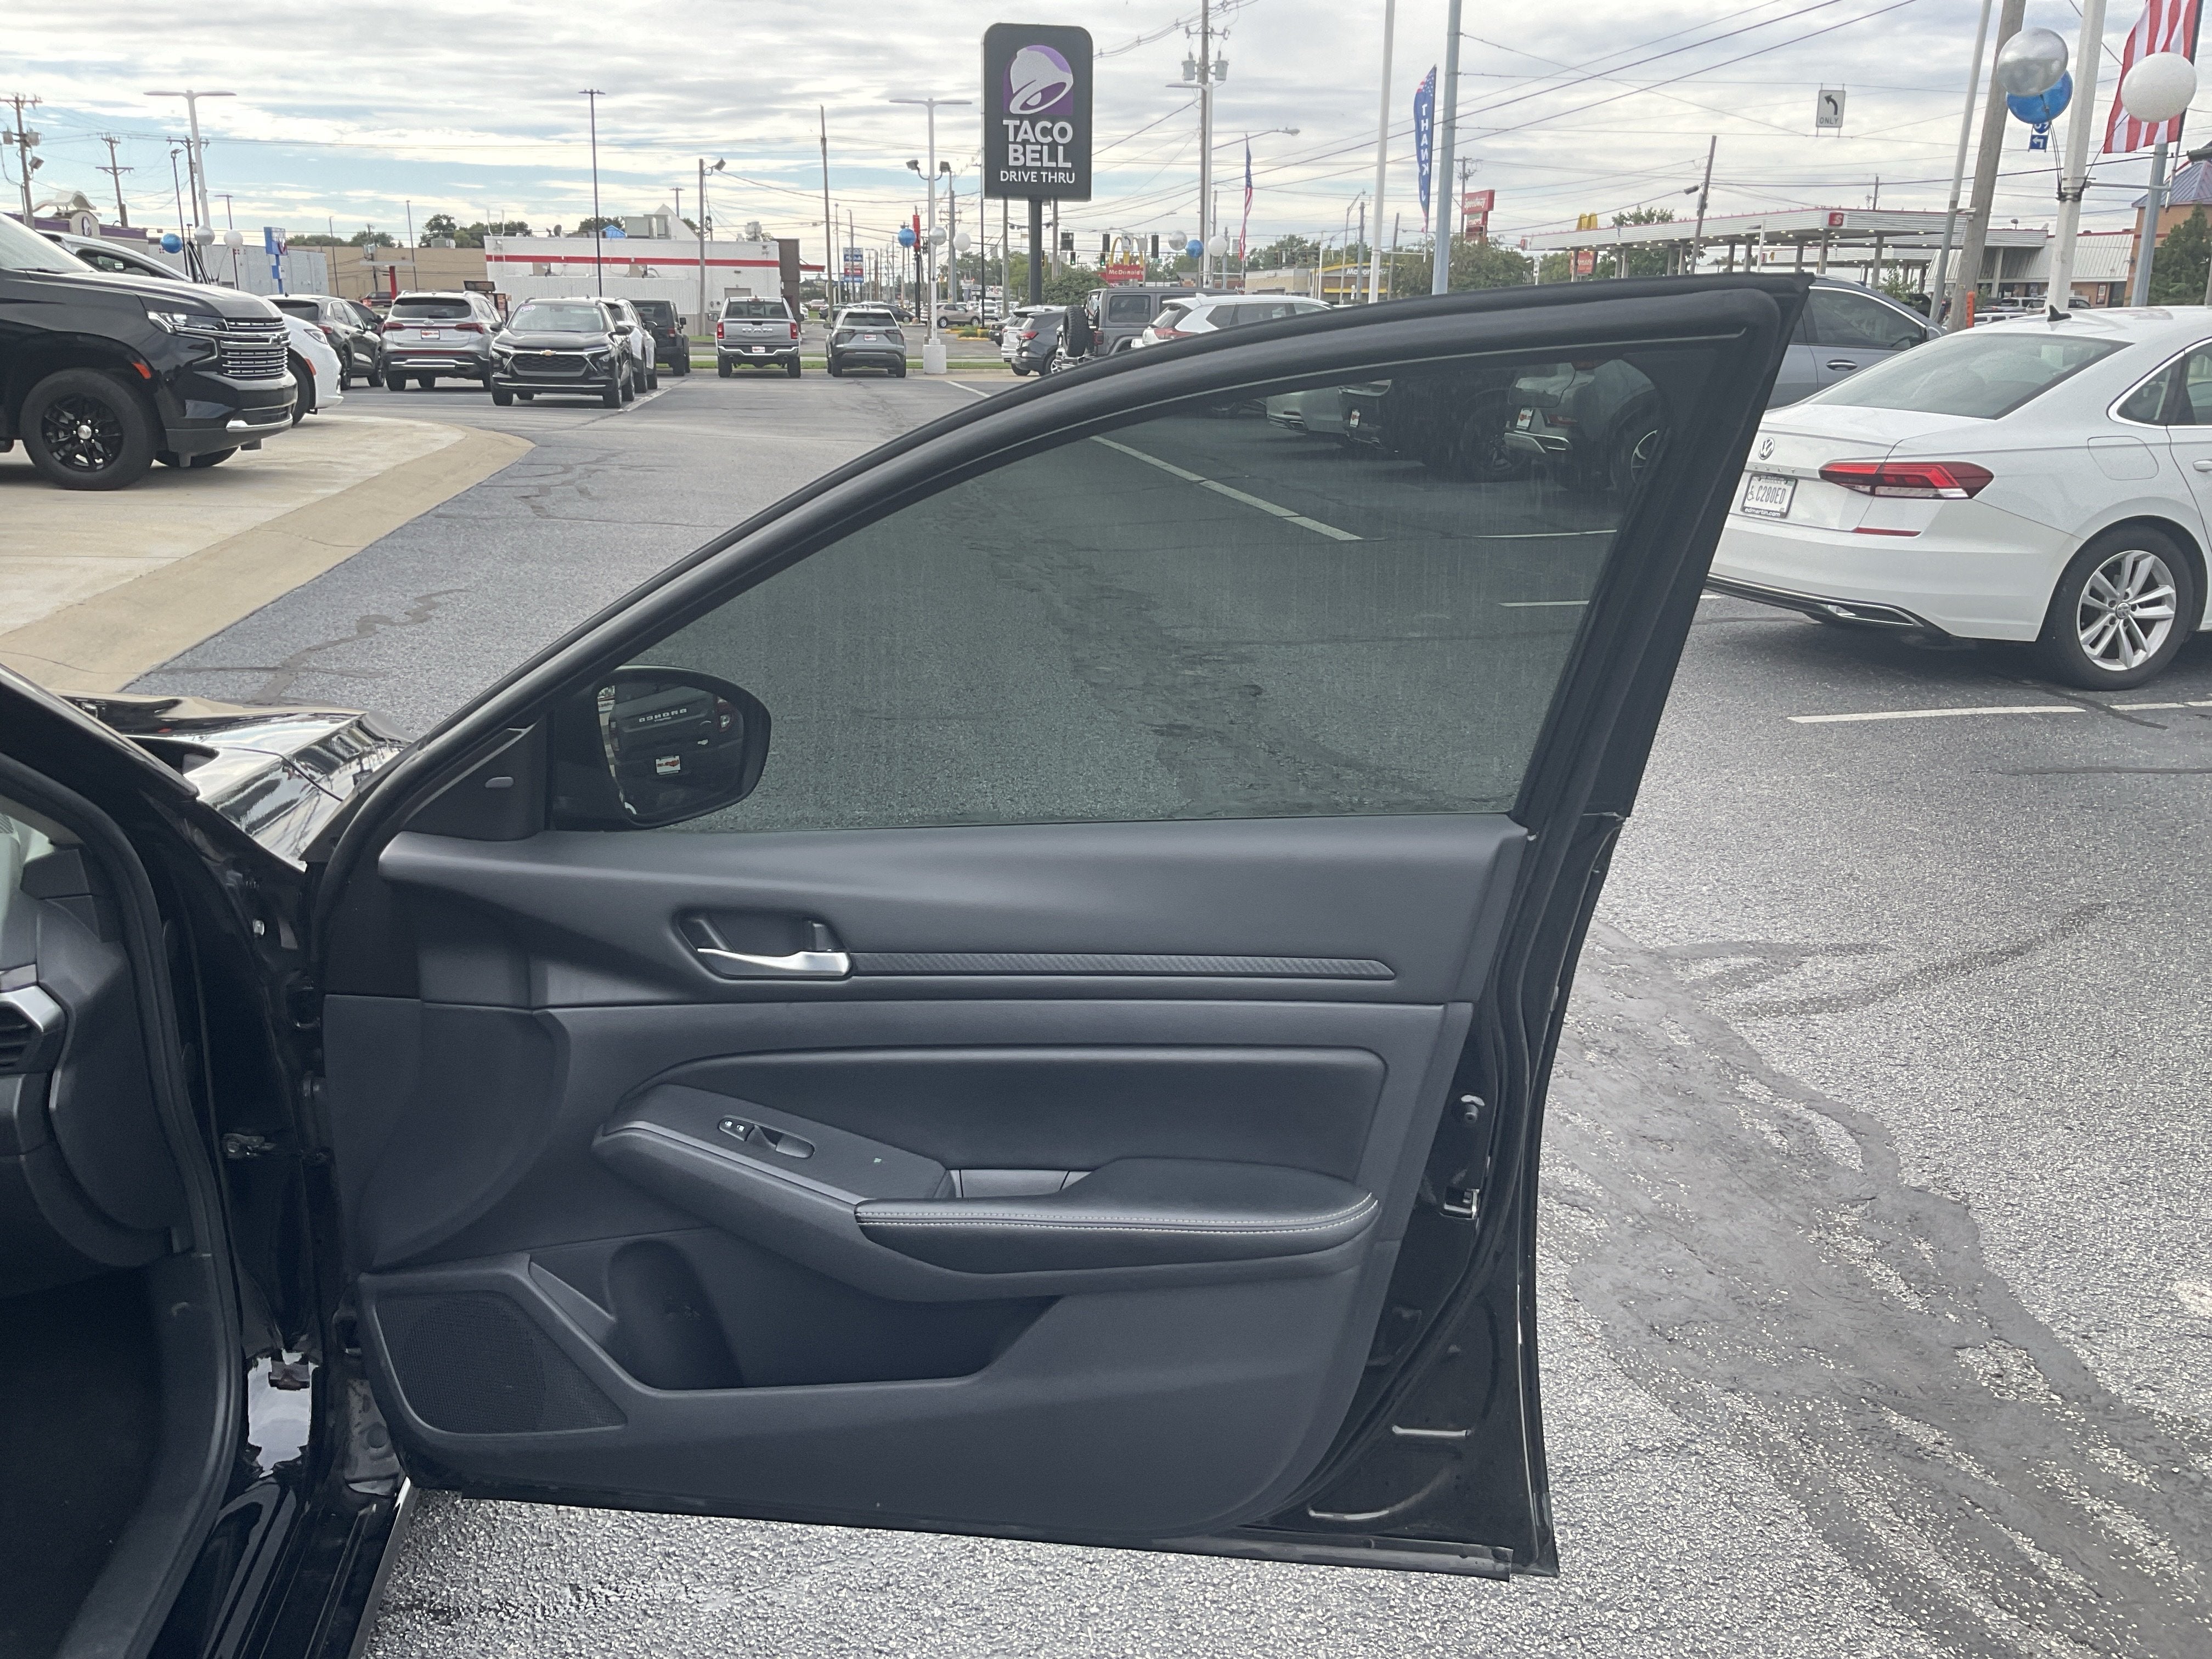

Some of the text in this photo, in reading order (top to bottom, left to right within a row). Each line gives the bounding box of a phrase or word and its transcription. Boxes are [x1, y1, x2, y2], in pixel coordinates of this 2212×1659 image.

[1003, 120, 1073, 144] TACO
[1008, 144, 1071, 168] BELL
[1000, 171, 1075, 184] DRIVE THRU
[1464, 196, 1486, 211] Speedway
[1745, 507, 1781, 517] edmartin.com
